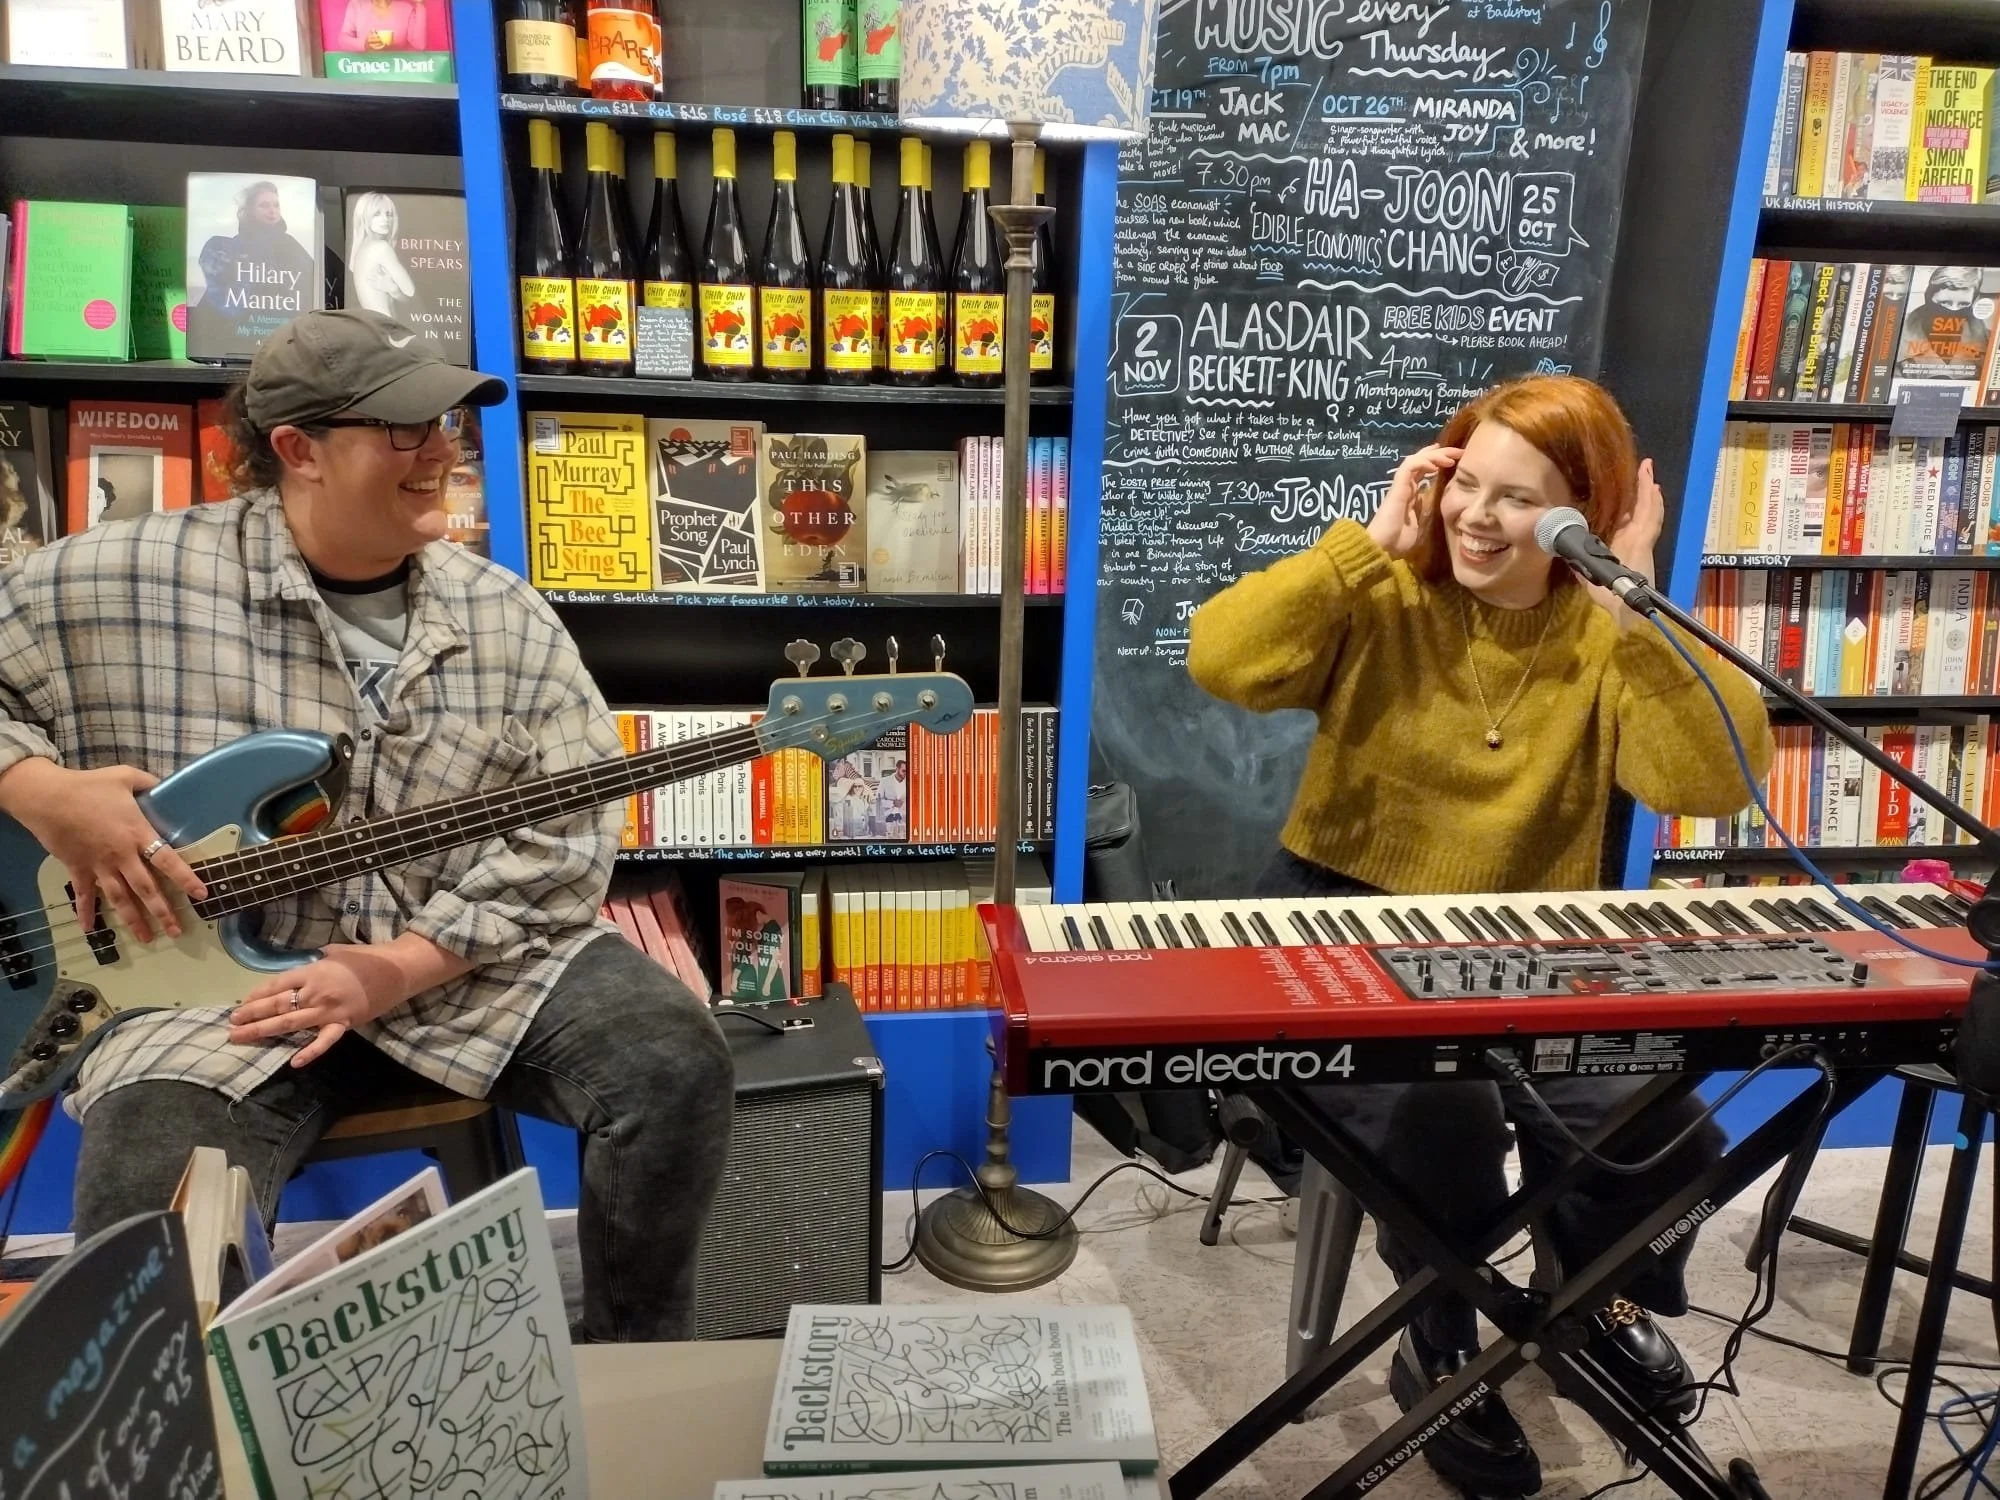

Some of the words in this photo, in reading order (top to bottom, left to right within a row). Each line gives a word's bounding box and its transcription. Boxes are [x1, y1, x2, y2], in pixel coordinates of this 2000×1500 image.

[191, 11, 265, 33] MARY
[1195, 0, 1344, 59] MUSIC
[1347, 0, 1449, 38] every
[176, 35, 285, 64] BEARD
[1360, 30, 1506, 83] Thursday
[338, 57, 390, 74] Grace
[394, 58, 434, 74] Dent
[1208, 57, 1248, 73] FROM
[1255, 57, 1300, 90] 7pm
[1930, 70, 1953, 88] THE
[1955, 71, 1977, 88] END
[501, 94, 544, 112] Takeaway
[545, 99, 577, 113] bottles
[581, 101, 610, 114] Cava
[612, 102, 638, 115] £21
[648, 103, 674, 118] Red
[680, 105, 708, 120] £16
[714, 108, 747, 122] Rosé
[754, 109, 782, 124] £18
[787, 111, 815, 125] Chin
[820, 110, 847, 126] Chin
[1219, 87, 1284, 116] JACK
[1322, 95, 1361, 114] OCT
[1413, 97, 1516, 121] MIRANDA
[1944, 90, 1959, 108] OF
[1238, 121, 1290, 145] MAC
[1405, 124, 1424, 134] with
[1443, 123, 1489, 146] JOY
[1509, 128, 1529, 158] &
[1534, 128, 1596, 156] more!
[1925, 148, 1965, 166] SIMON
[1135, 194, 1165, 209] SOAS
[1171, 196, 1221, 211] economist
[1304, 157, 1510, 235] HA-JOON
[1522, 185, 1559, 214] 25
[1765, 197, 1781, 208] UK
[1826, 200, 1873, 212] HISTORY
[1519, 220, 1557, 240] OCT
[400, 238, 462, 253] BRITNEY
[1387, 229, 1491, 276] CHANG
[236, 261, 301, 291] Hilary
[410, 257, 463, 271] SPEARS
[580, 284, 600, 294] CHIN
[602, 285, 622, 295] CHIN
[1818, 266, 1834, 302] Black
[1869, 269, 1882, 300] BLACK
[225, 288, 300, 312] Mantel
[437, 298, 462, 308] THE
[961, 299, 981, 309] CHIN
[984, 300, 999, 309] CHIN
[410, 313, 462, 324] WOMAN
[1383, 305, 1432, 329] FREE
[1435, 305, 1485, 330] KIDS
[1488, 306, 1560, 332] EVENT
[1812, 305, 1826, 329] and
[1864, 300, 1875, 327] GOLD
[1932, 317, 1966, 333] SAY
[425, 330, 438, 339] IN
[446, 331, 462, 340] ME
[1135, 321, 1158, 358] 2
[1190, 301, 1373, 359] ALASDAIR
[1461, 335, 1495, 348] PLEASE
[1498, 336, 1525, 348] BOOK
[1529, 335, 1568, 348] AHEAD!
[1857, 328, 1869, 353] JEREMY
[1805, 330, 1820, 376] British
[1124, 359, 1171, 382] NOV
[1188, 355, 1349, 400] BECKETT-KING
[1853, 353, 1865, 381] PAXMAN
[1367, 401, 1382, 415] at
[1399, 399, 1422, 415] the
[77, 411, 179, 430] WIFEDOM
[1122, 408, 1151, 424] Have
[1156, 415, 1177, 431] you
[1184, 412, 1201, 431] got
[1206, 412, 1230, 423] what
[1235, 412, 1244, 424] it
[1248, 412, 1273, 425] takes
[1277, 415, 1288, 425] to
[1292, 415, 1302, 426] be
[565, 431, 607, 455] Paul
[1790, 430, 1811, 475] RUSSIA
[771, 451, 799, 459] PAUL
[804, 451, 855, 460] HARDING
[553, 459, 621, 489] Murray
[784, 479, 842, 492] THIS
[1120, 478, 1147, 487] COSTA
[1151, 477, 1177, 487] PRIZE
[1832, 457, 1844, 501] GERMANY
[569, 489, 604, 514] The
[1927, 482, 1936, 501] RED
[773, 511, 856, 525] OTHER
[1767, 478, 1781, 535] STALINGRAD
[570, 520, 605, 543] Bee
[661, 509, 718, 533] Prophet
[1924, 504, 1934, 541] NOTICE
[670, 526, 708, 546] Song
[720, 538, 750, 554] Paul
[562, 548, 615, 577] Sting
[783, 544, 846, 557] EDEN
[1743, 555, 1791, 566] HISTORY
[713, 556, 756, 572] Lynch
[546, 590, 564, 602] The
[568, 591, 606, 603] Booker
[613, 592, 659, 604] Shortlist
[676, 594, 701, 604] Pick
[707, 597, 726, 609] your
[730, 595, 788, 605] favourite
[797, 595, 818, 607] Paul
[1956, 578, 1970, 622] INDIA
[1900, 596, 1913, 644] AFTERMATH
[1827, 782, 1840, 832] FRANCE
[615, 852, 630, 860] one
[634, 850, 644, 860] of
[647, 852, 660, 860] our
[661, 850, 684, 860] book
[688, 848, 714, 859] clubs?
[714, 850, 733, 859] The
[737, 850, 764, 859] author
[771, 850, 791, 859] joins
[805, 850, 826, 859] every
[831, 846, 861, 857] month!
[866, 845, 886, 856] Pick
[891, 848, 901, 857] up
[918, 845, 956, 856] leaflet
[963, 845, 978, 854] for
[1664, 849, 1725, 861] BIOGRAPHY
[725, 927, 741, 938] I'M
[746, 930, 785, 944] SORRY
[729, 940, 752, 952] YOU
[726, 952, 754, 965] THAT
[759, 958, 784, 969] WY
[1045, 1050, 1152, 1088] nord
[1165, 1048, 1321, 1084] electro
[1326, 1044, 1355, 1078] 4
[1649, 1198, 1717, 1256] DURONIC
[248, 1206, 528, 1380] Backstory
[1048, 1321, 1061, 1349] boom
[1049, 1351, 1065, 1376] book
[783, 1315, 852, 1453] Backstory
[1052, 1379, 1069, 1407] Irish
[1056, 1410, 1072, 1436] The
[1356, 1464, 1387, 1490] KS2
[1385, 1413, 1450, 1467] keyboard
[1450, 1381, 1489, 1417] stand
